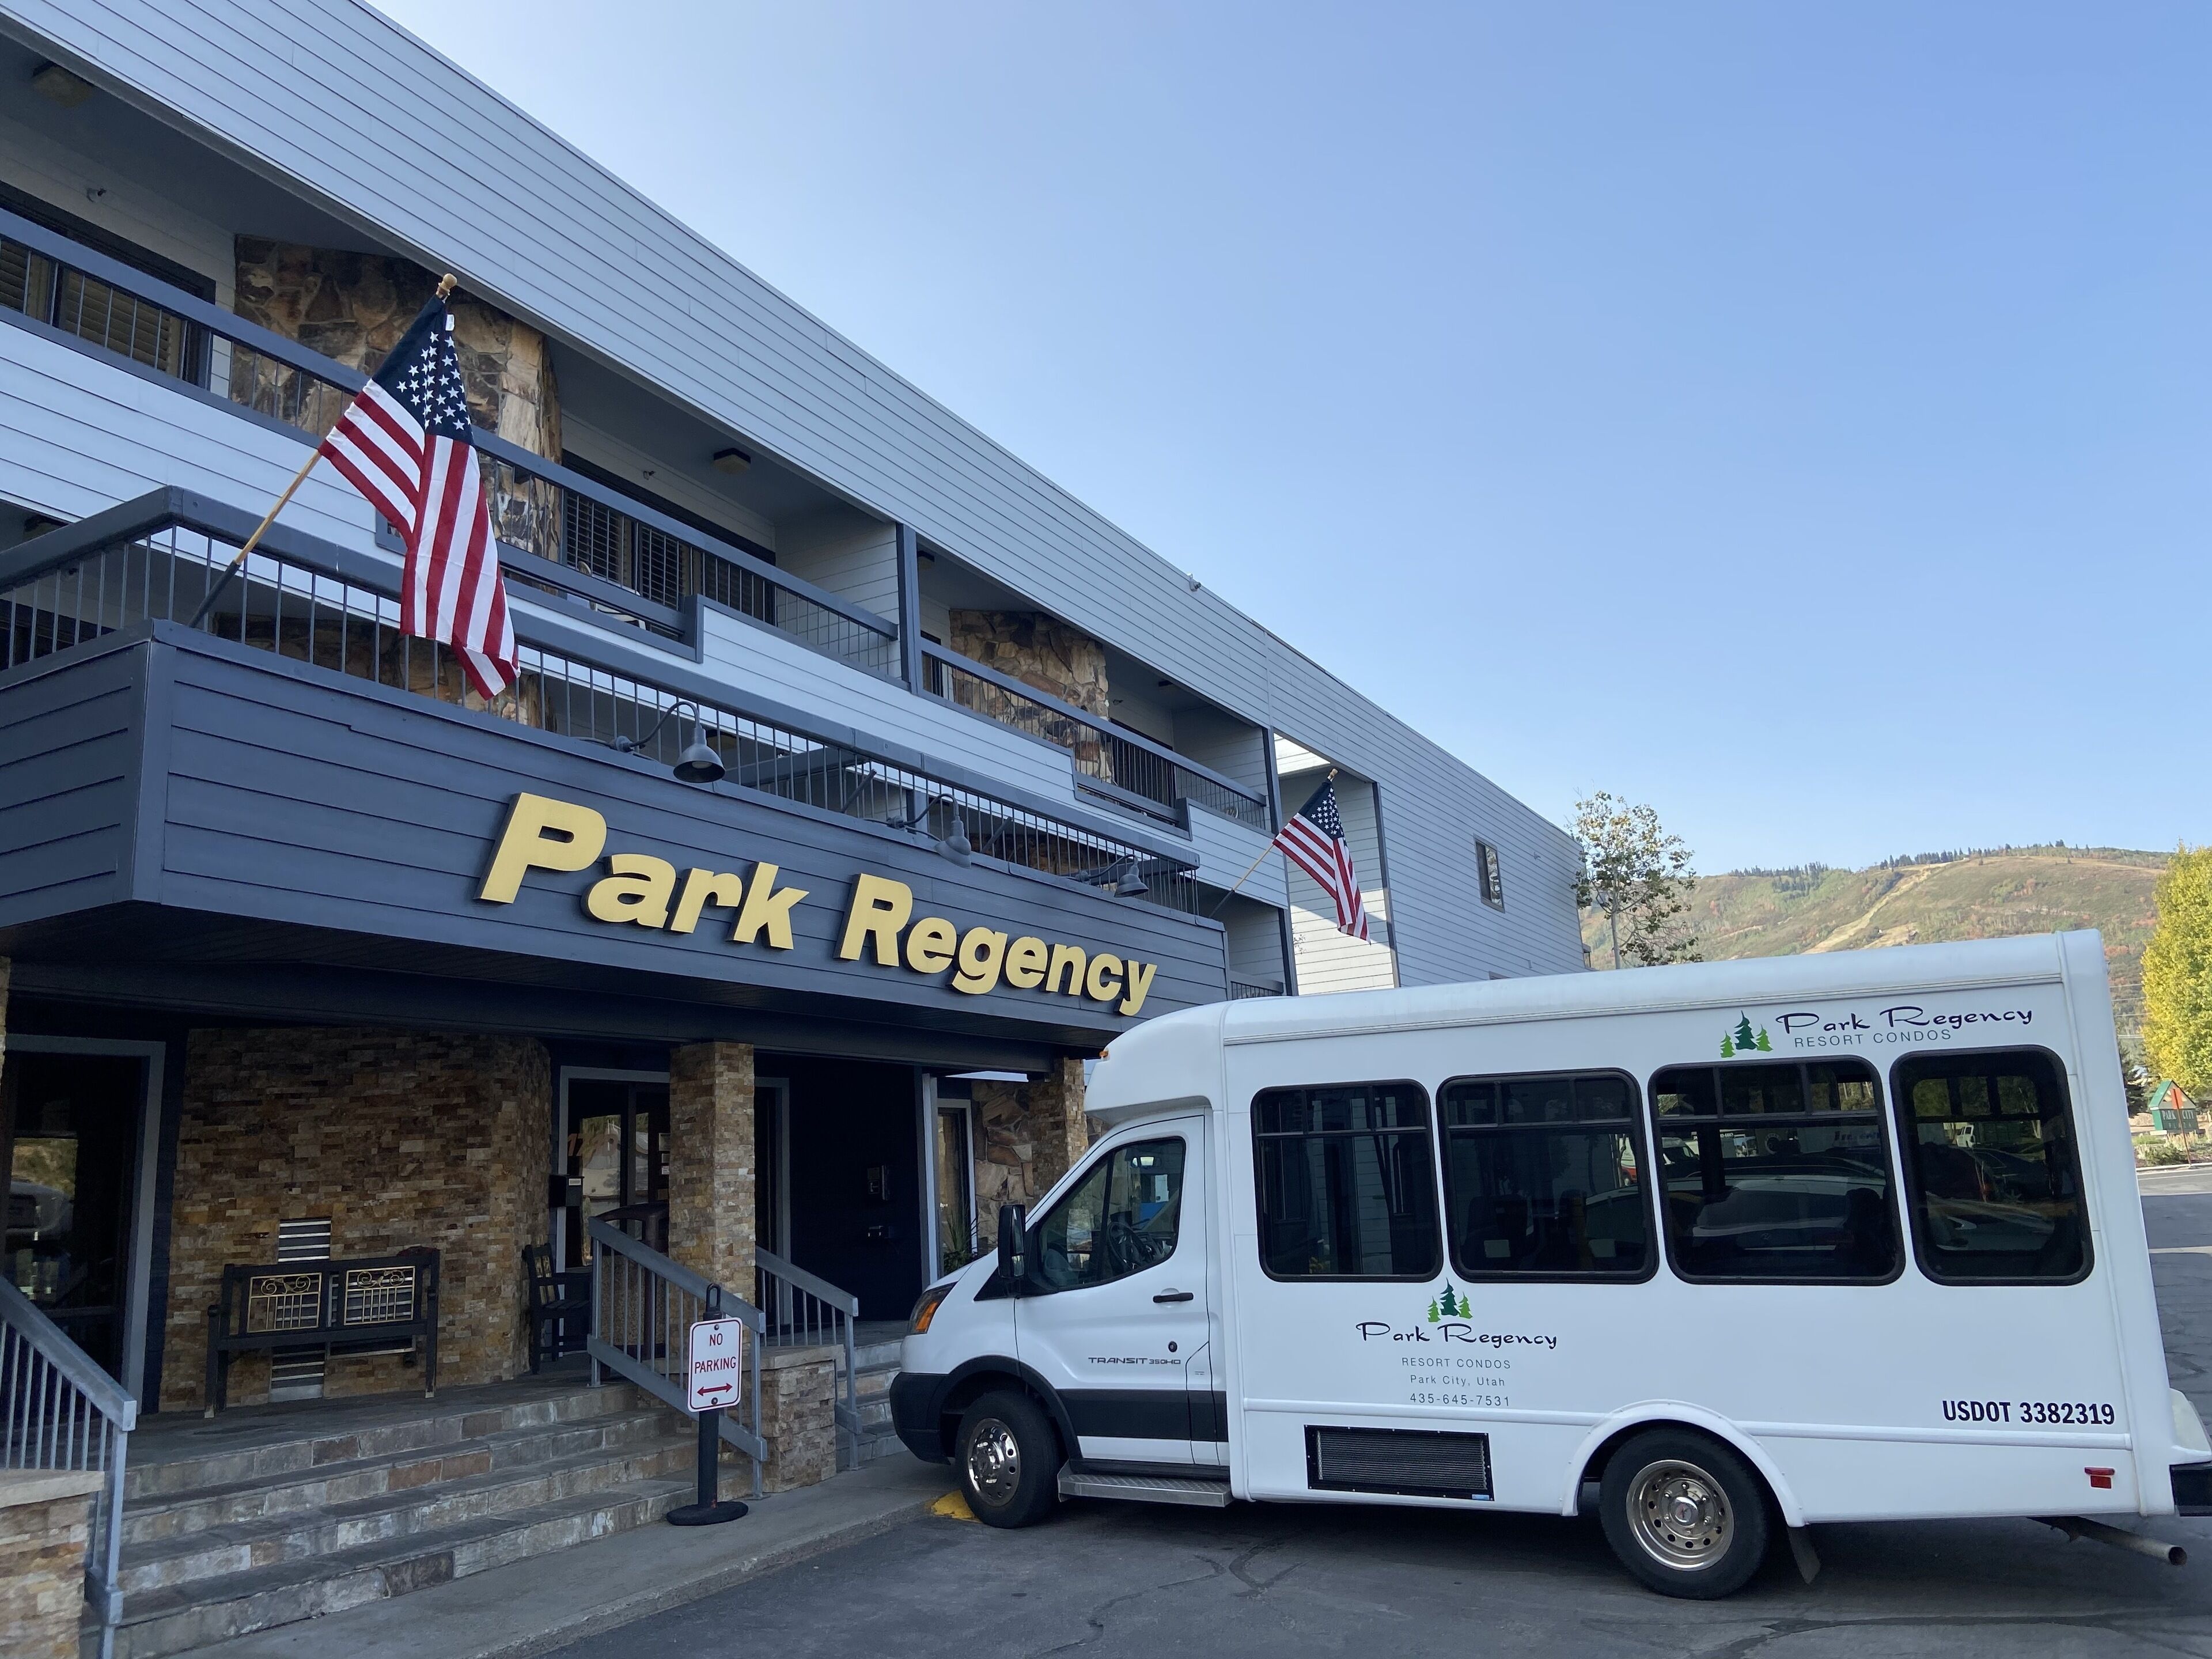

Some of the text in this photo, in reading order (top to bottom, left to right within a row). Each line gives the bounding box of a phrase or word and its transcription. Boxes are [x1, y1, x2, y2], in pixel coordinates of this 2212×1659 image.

[476, 793, 1158, 1016] Park Regency
[1775, 1006, 2032, 1033] Park Regency
[1794, 1029, 1951, 1048] RESORT CONDOS
[2162, 1109, 2194, 1120] PARK CITY
[709, 1333, 723, 1346] NO
[1356, 1322, 1556, 1349] Park Regency
[694, 1356, 736, 1374] PARKING
[1402, 1358, 1510, 1369] RESORT CONDOS
[1410, 1375, 1505, 1387] Park City, Utah
[1410, 1393, 1509, 1406] 435-645-7531
[1942, 1400, 2115, 1425] USDOT 3382319
